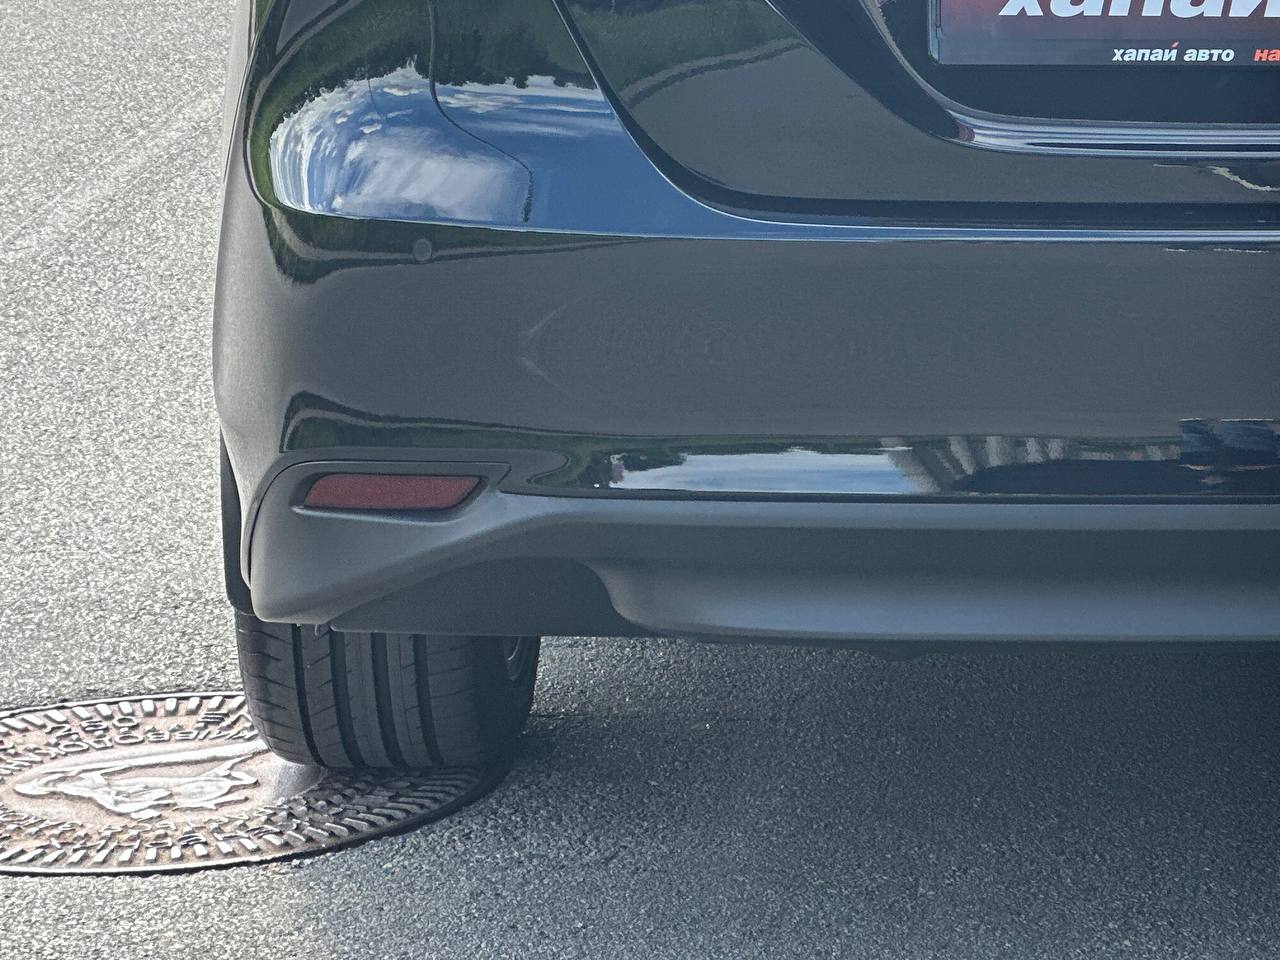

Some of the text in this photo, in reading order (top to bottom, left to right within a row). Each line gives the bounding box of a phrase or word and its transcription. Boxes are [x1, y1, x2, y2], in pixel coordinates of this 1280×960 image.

[1112, 42, 1181, 62] хапай
[1183, 47, 1235, 62] авто
[1254, 48, 1280, 62] на
